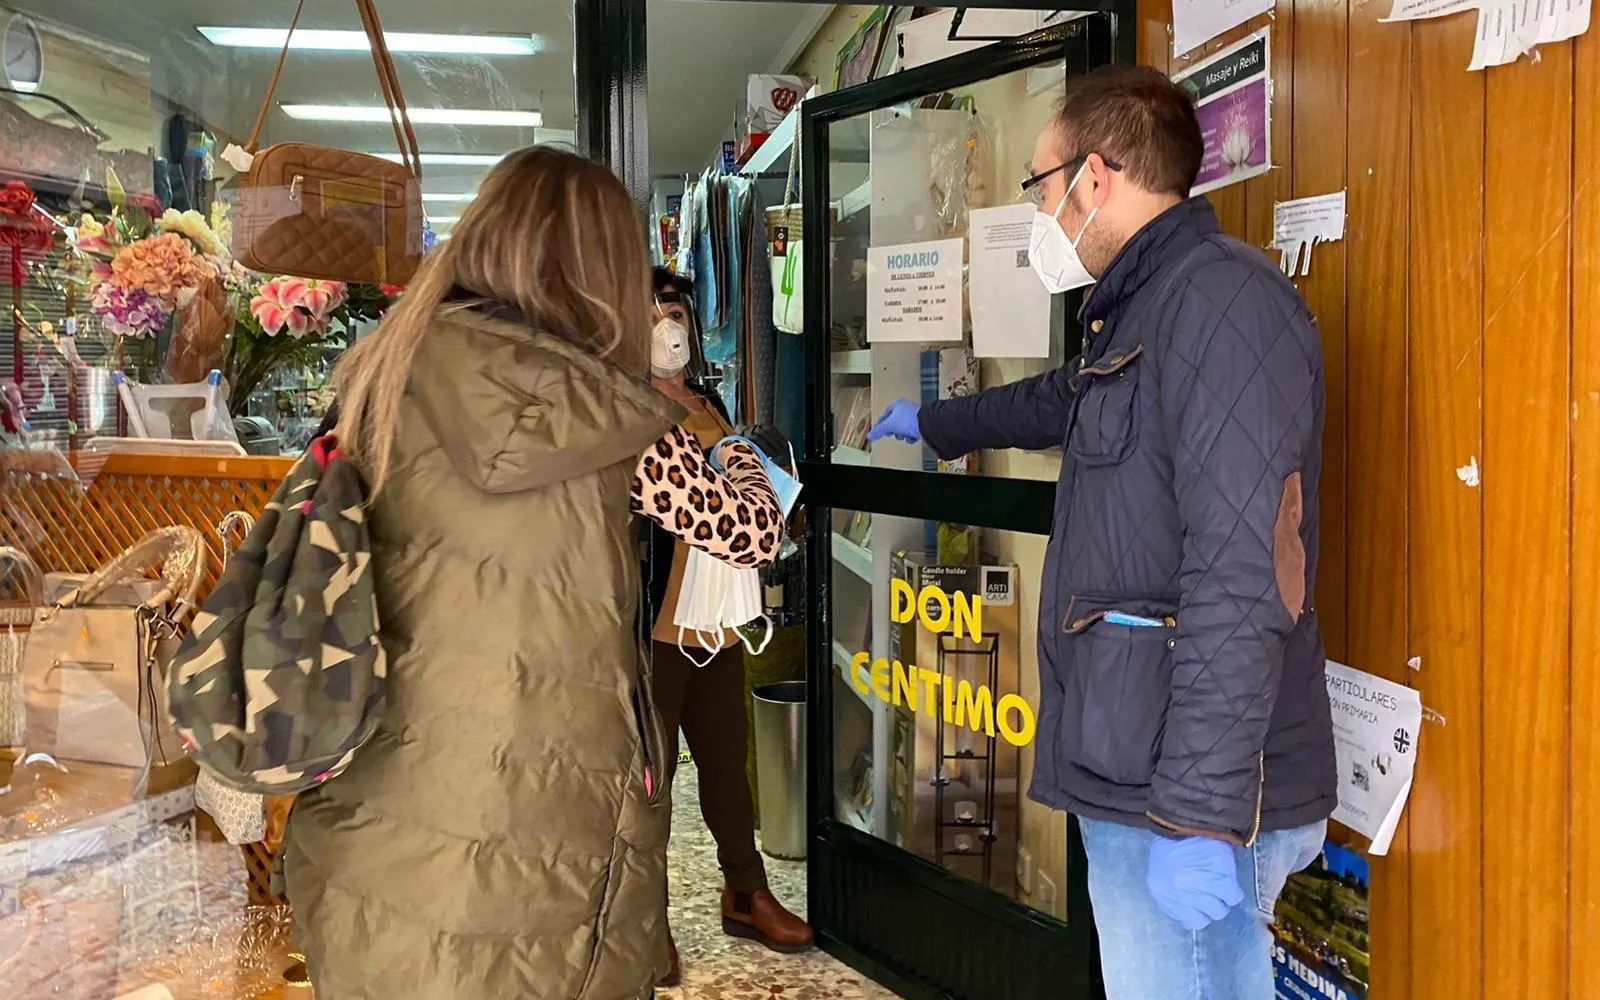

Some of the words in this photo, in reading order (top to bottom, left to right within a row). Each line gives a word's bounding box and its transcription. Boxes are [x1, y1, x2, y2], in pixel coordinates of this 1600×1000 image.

[1205, 62, 1231, 87] Masaje
[1233, 64, 1239, 76] y
[1239, 50, 1259, 70] Reiki
[887, 251, 939, 269] HORARIO
[922, 566, 944, 574] Candle
[945, 567, 967, 575] holder
[985, 593, 1008, 601] CASA
[987, 584, 1007, 592] ARTI
[891, 577, 982, 644] DON
[850, 651, 1036, 747] CENTIMO
[1341, 702, 1378, 723] PRIMARIA
[1288, 953, 1348, 1000] MEDINA
